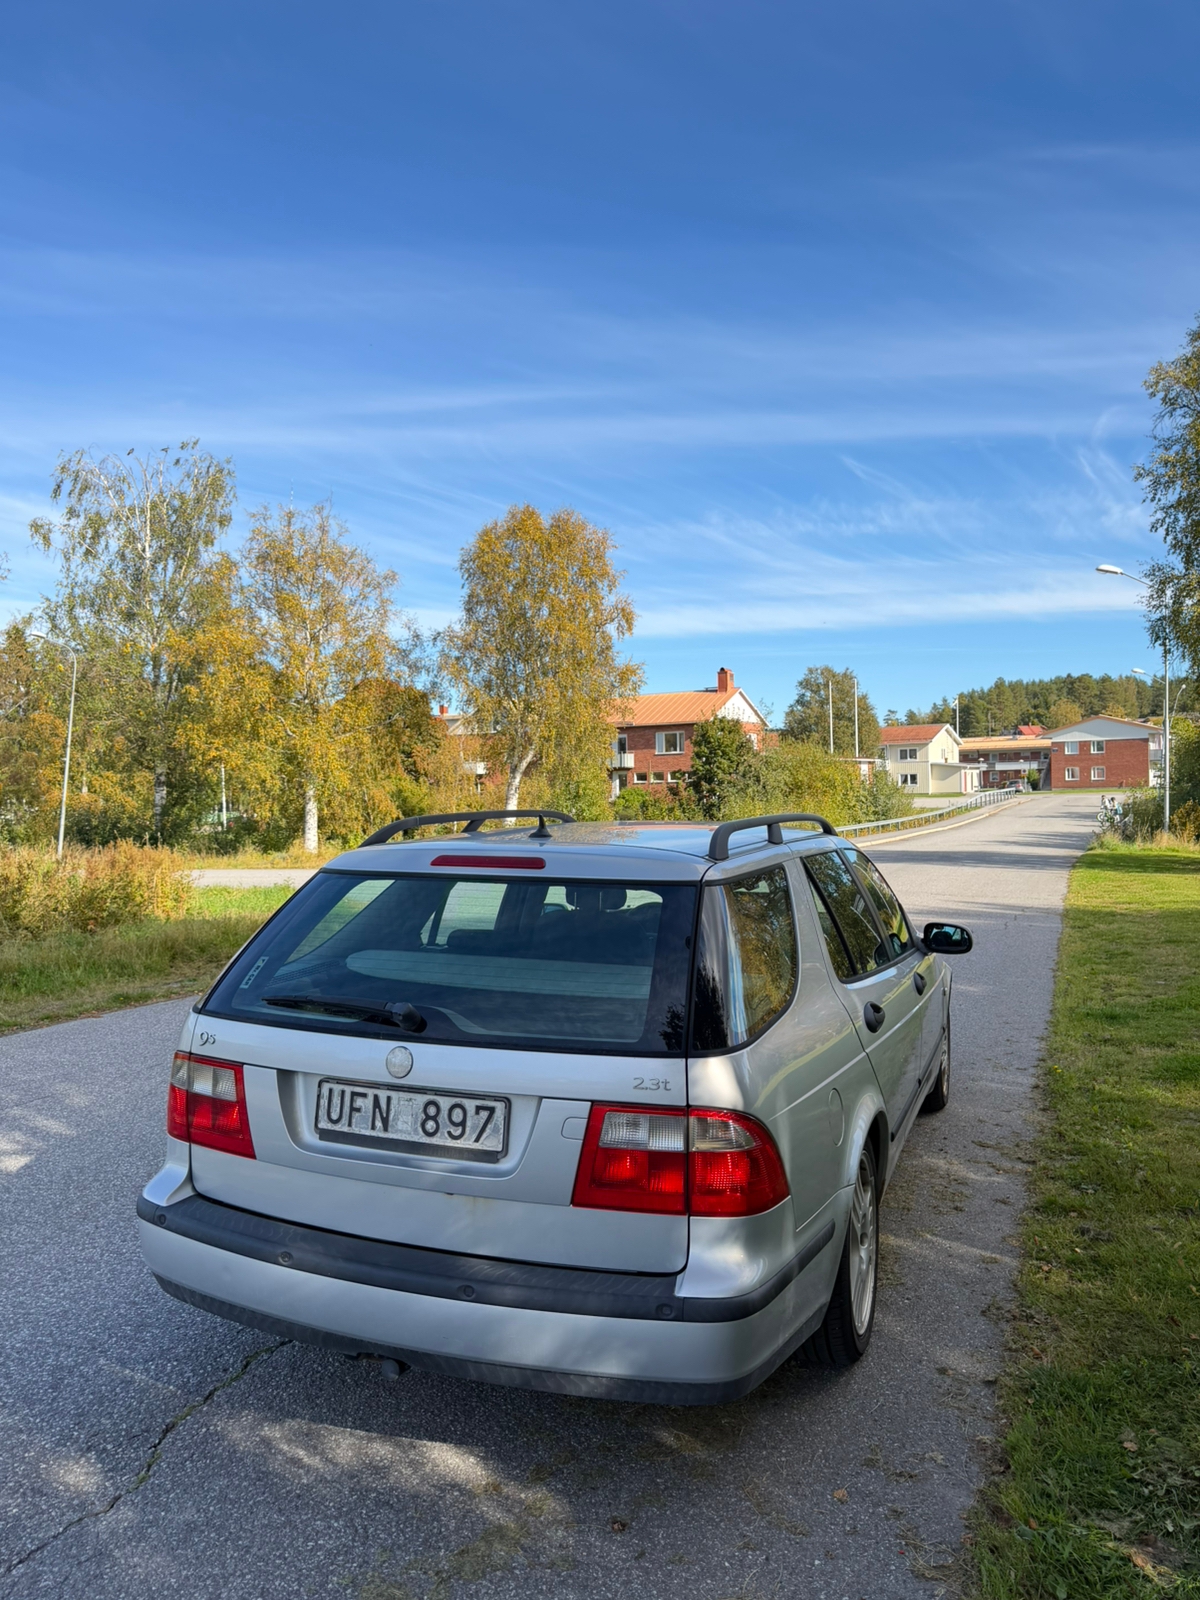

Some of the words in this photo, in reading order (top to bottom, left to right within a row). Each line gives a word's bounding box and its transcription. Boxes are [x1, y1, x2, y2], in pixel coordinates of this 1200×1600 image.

[633, 1077, 672, 1092] 2.3t
[326, 1087, 392, 1132] UFN
[421, 1100, 496, 1143] 897
